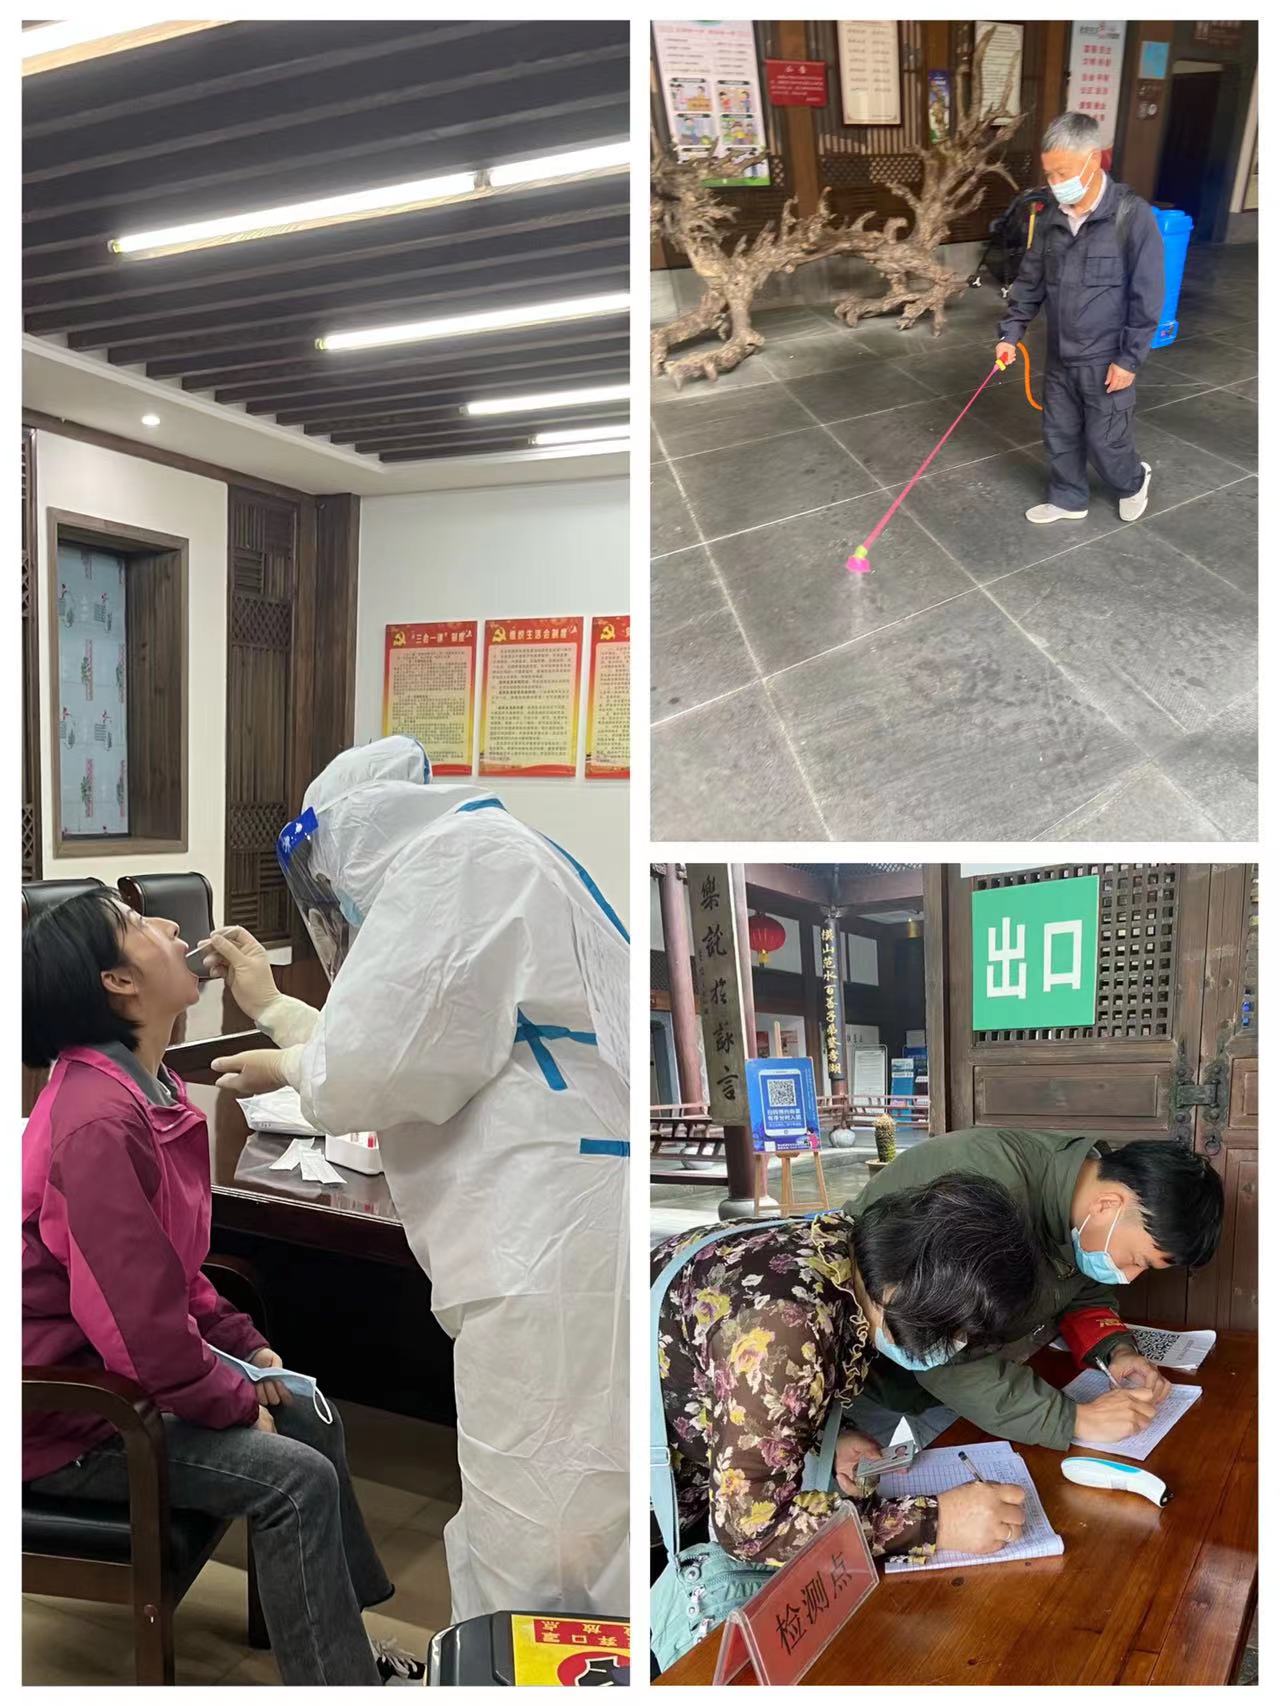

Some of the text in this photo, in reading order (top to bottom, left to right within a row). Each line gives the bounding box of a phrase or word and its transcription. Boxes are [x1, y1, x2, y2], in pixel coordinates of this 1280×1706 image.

[986, 916, 1083, 1000] 出口
[776, 1551, 853, 1656] 检测点
